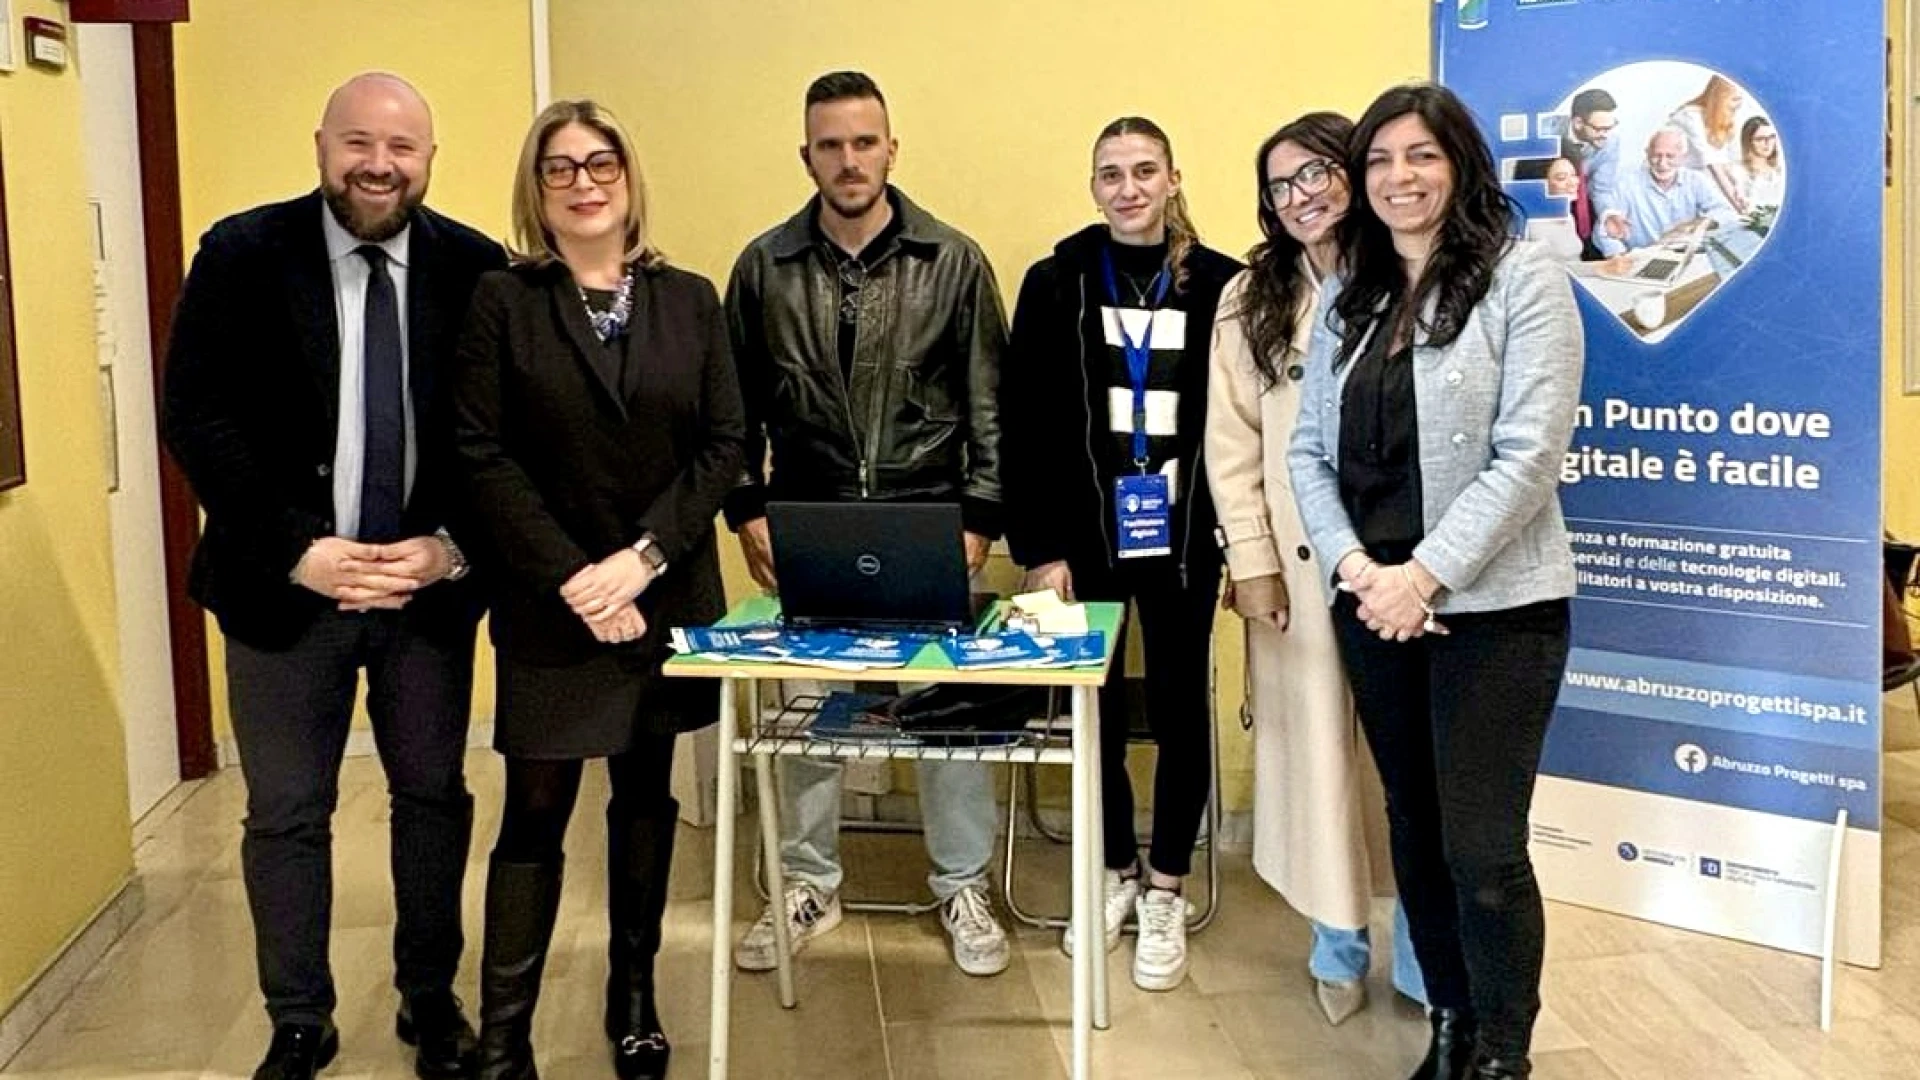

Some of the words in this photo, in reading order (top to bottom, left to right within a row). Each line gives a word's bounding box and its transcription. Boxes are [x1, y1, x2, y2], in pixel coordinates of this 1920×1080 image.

[1605, 399, 1719, 433] Punto
[1730, 402, 1831, 438] dove
[1559, 446, 1663, 483] gitale
[1674, 449, 1697, 482] è
[1707, 451, 1820, 489] facile
[1606, 534, 1617, 546] e
[1620, 532, 1716, 555] formazione
[1719, 543, 1792, 561] gratuita
[1624, 556, 1635, 569] e
[1638, 555, 1677, 572] delle
[1681, 559, 1772, 583] tecnologie
[1776, 566, 1846, 588] digitali.
[1635, 579, 1646, 591] a
[1649, 580, 1704, 596] vostra
[1707, 583, 1824, 608] disposizione.
[1564, 671, 1867, 725] www.abruzzoprogettispa.it
[1712, 754, 1771, 776] Abruzzo
[1774, 763, 1834, 786] Progetti
[1838, 776, 1867, 791] spa
